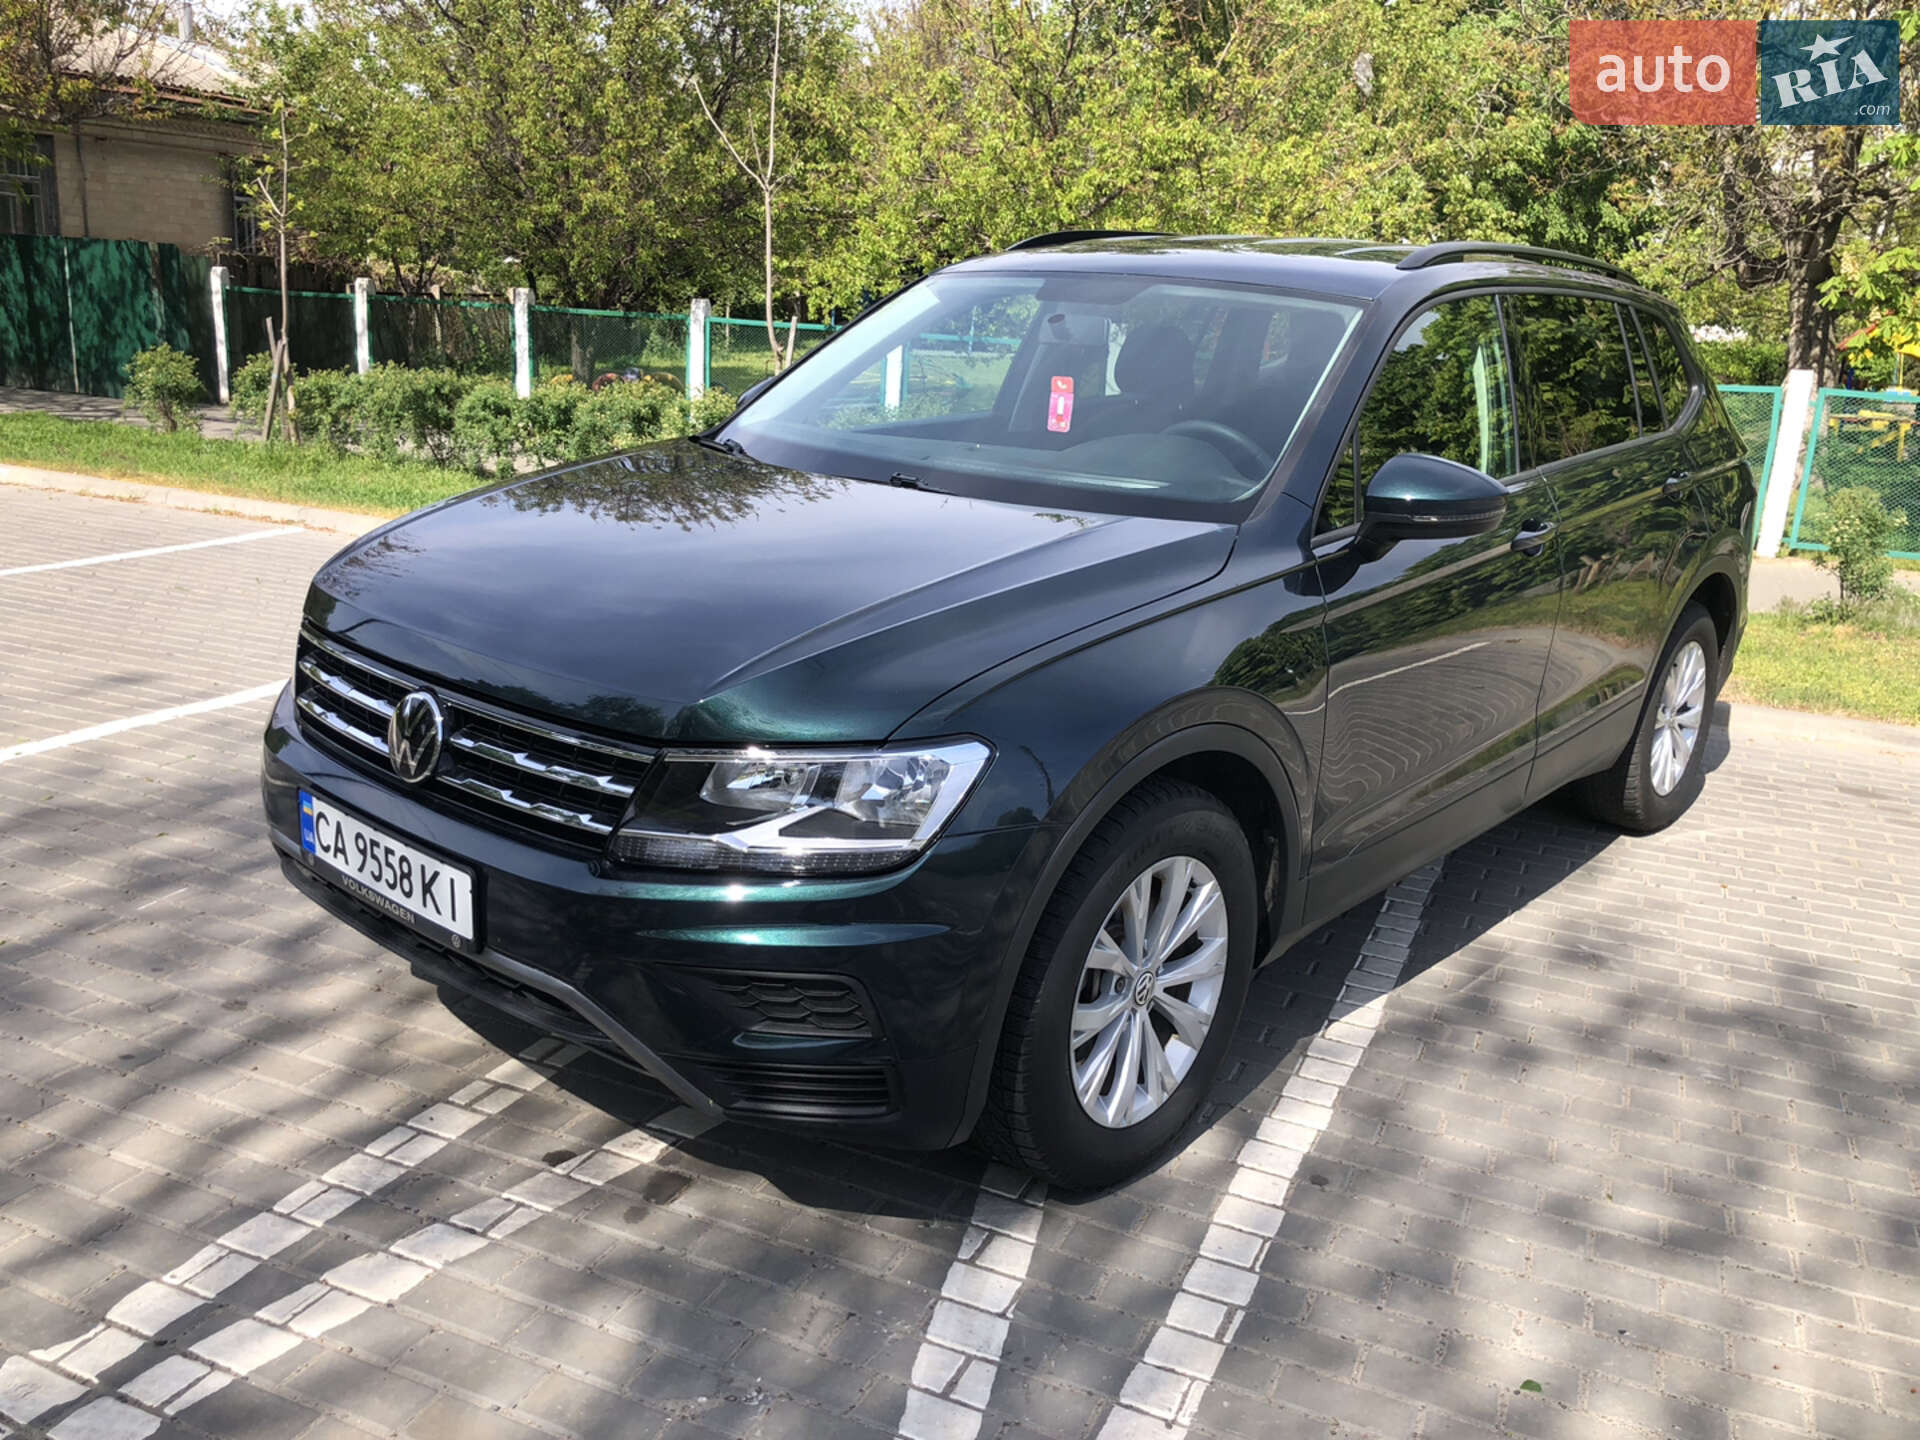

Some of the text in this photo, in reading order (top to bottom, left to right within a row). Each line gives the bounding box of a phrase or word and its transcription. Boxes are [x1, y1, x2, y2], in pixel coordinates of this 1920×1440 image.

[315, 811, 457, 923] CA 9558 KI
[341, 875, 415, 924] VOLKSWAGEN
